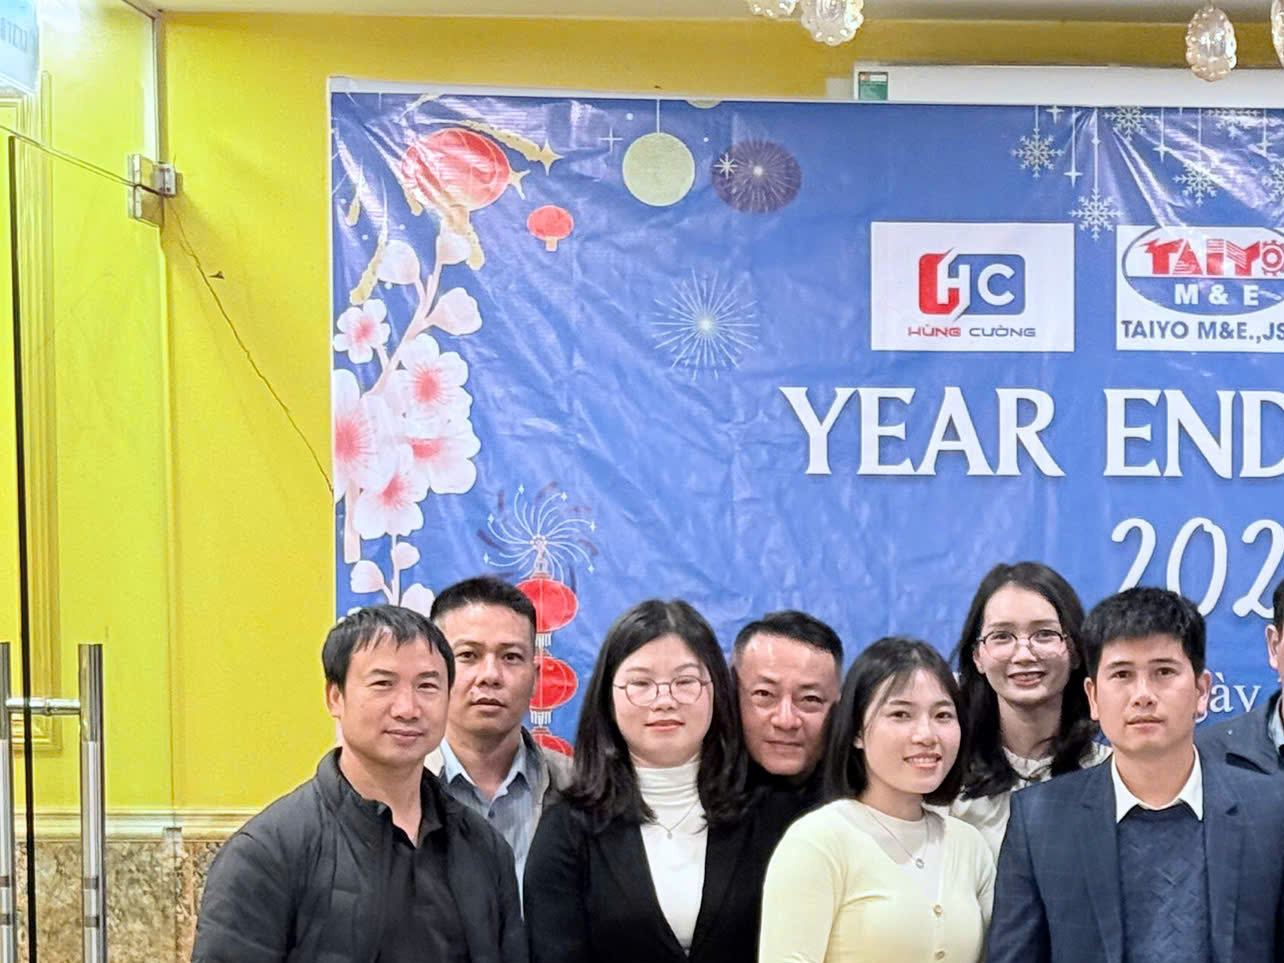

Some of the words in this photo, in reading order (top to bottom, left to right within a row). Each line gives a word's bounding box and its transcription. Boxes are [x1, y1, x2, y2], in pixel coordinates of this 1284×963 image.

[1174, 283, 1199, 305] M
[1208, 284, 1229, 305] &
[1243, 284, 1259, 306] E
[1121, 320, 1189, 340] TAIYO
[778, 386, 1067, 477] YEAR
